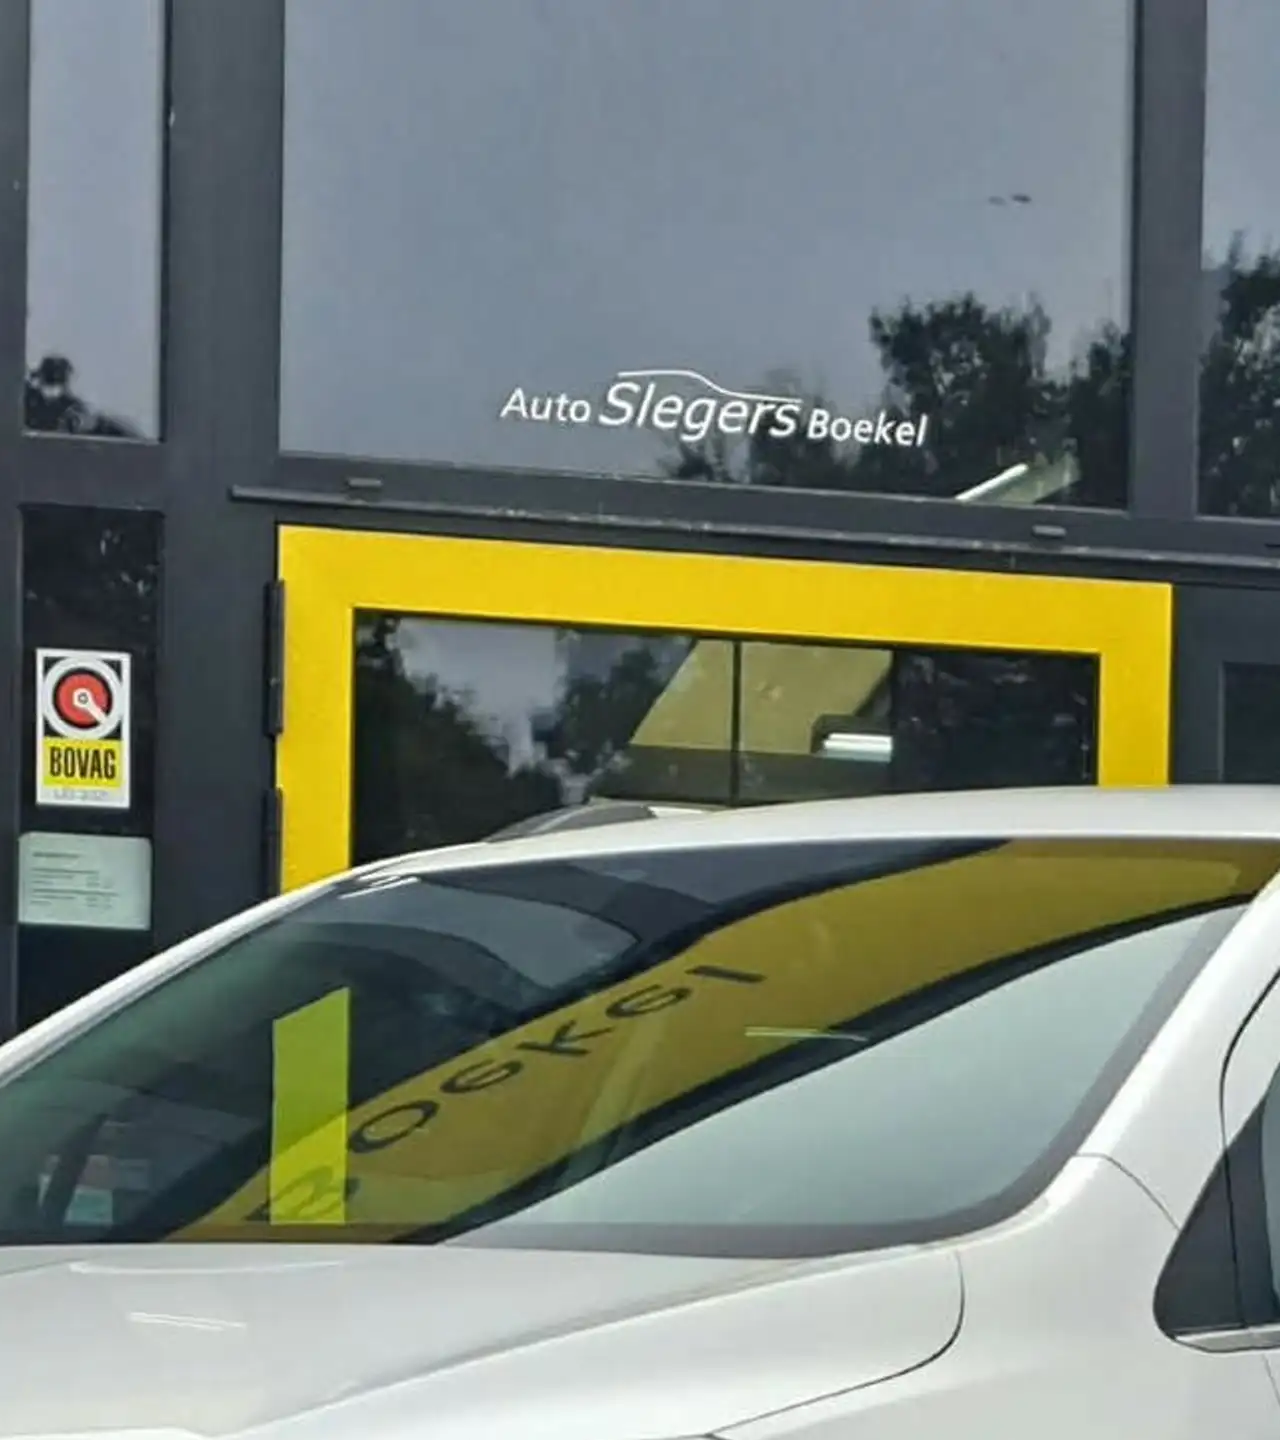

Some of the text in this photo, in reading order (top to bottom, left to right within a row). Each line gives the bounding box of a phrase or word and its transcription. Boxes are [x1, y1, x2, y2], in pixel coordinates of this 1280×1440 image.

[499, 382, 929, 448] Auto Slegers Boekel
[50, 747, 116, 780] BOVAG
